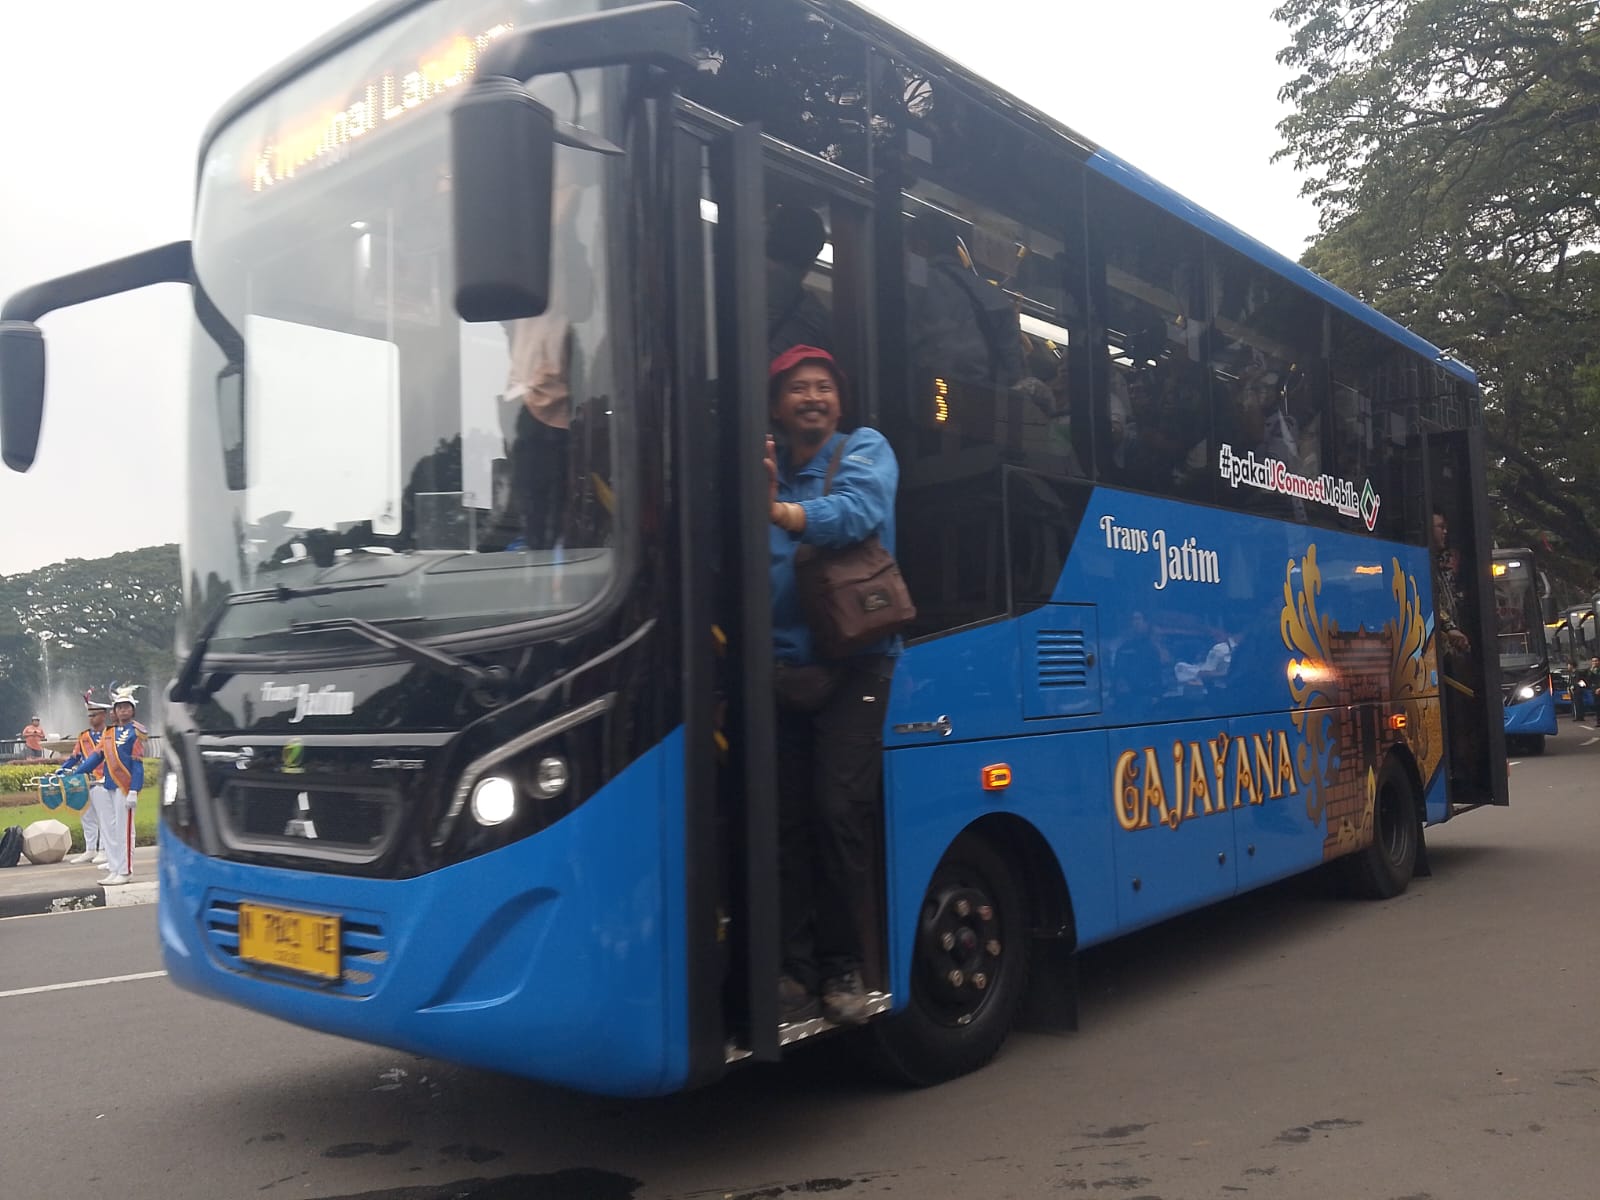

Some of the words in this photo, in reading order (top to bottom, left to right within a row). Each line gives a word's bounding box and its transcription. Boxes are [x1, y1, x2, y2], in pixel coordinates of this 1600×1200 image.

[1219, 443, 1360, 509] #pakaiJConnectMobile
[1100, 515, 1149, 554] Trans
[1152, 530, 1220, 590] Jatim
[1114, 729, 1298, 832] GAJAYANA
